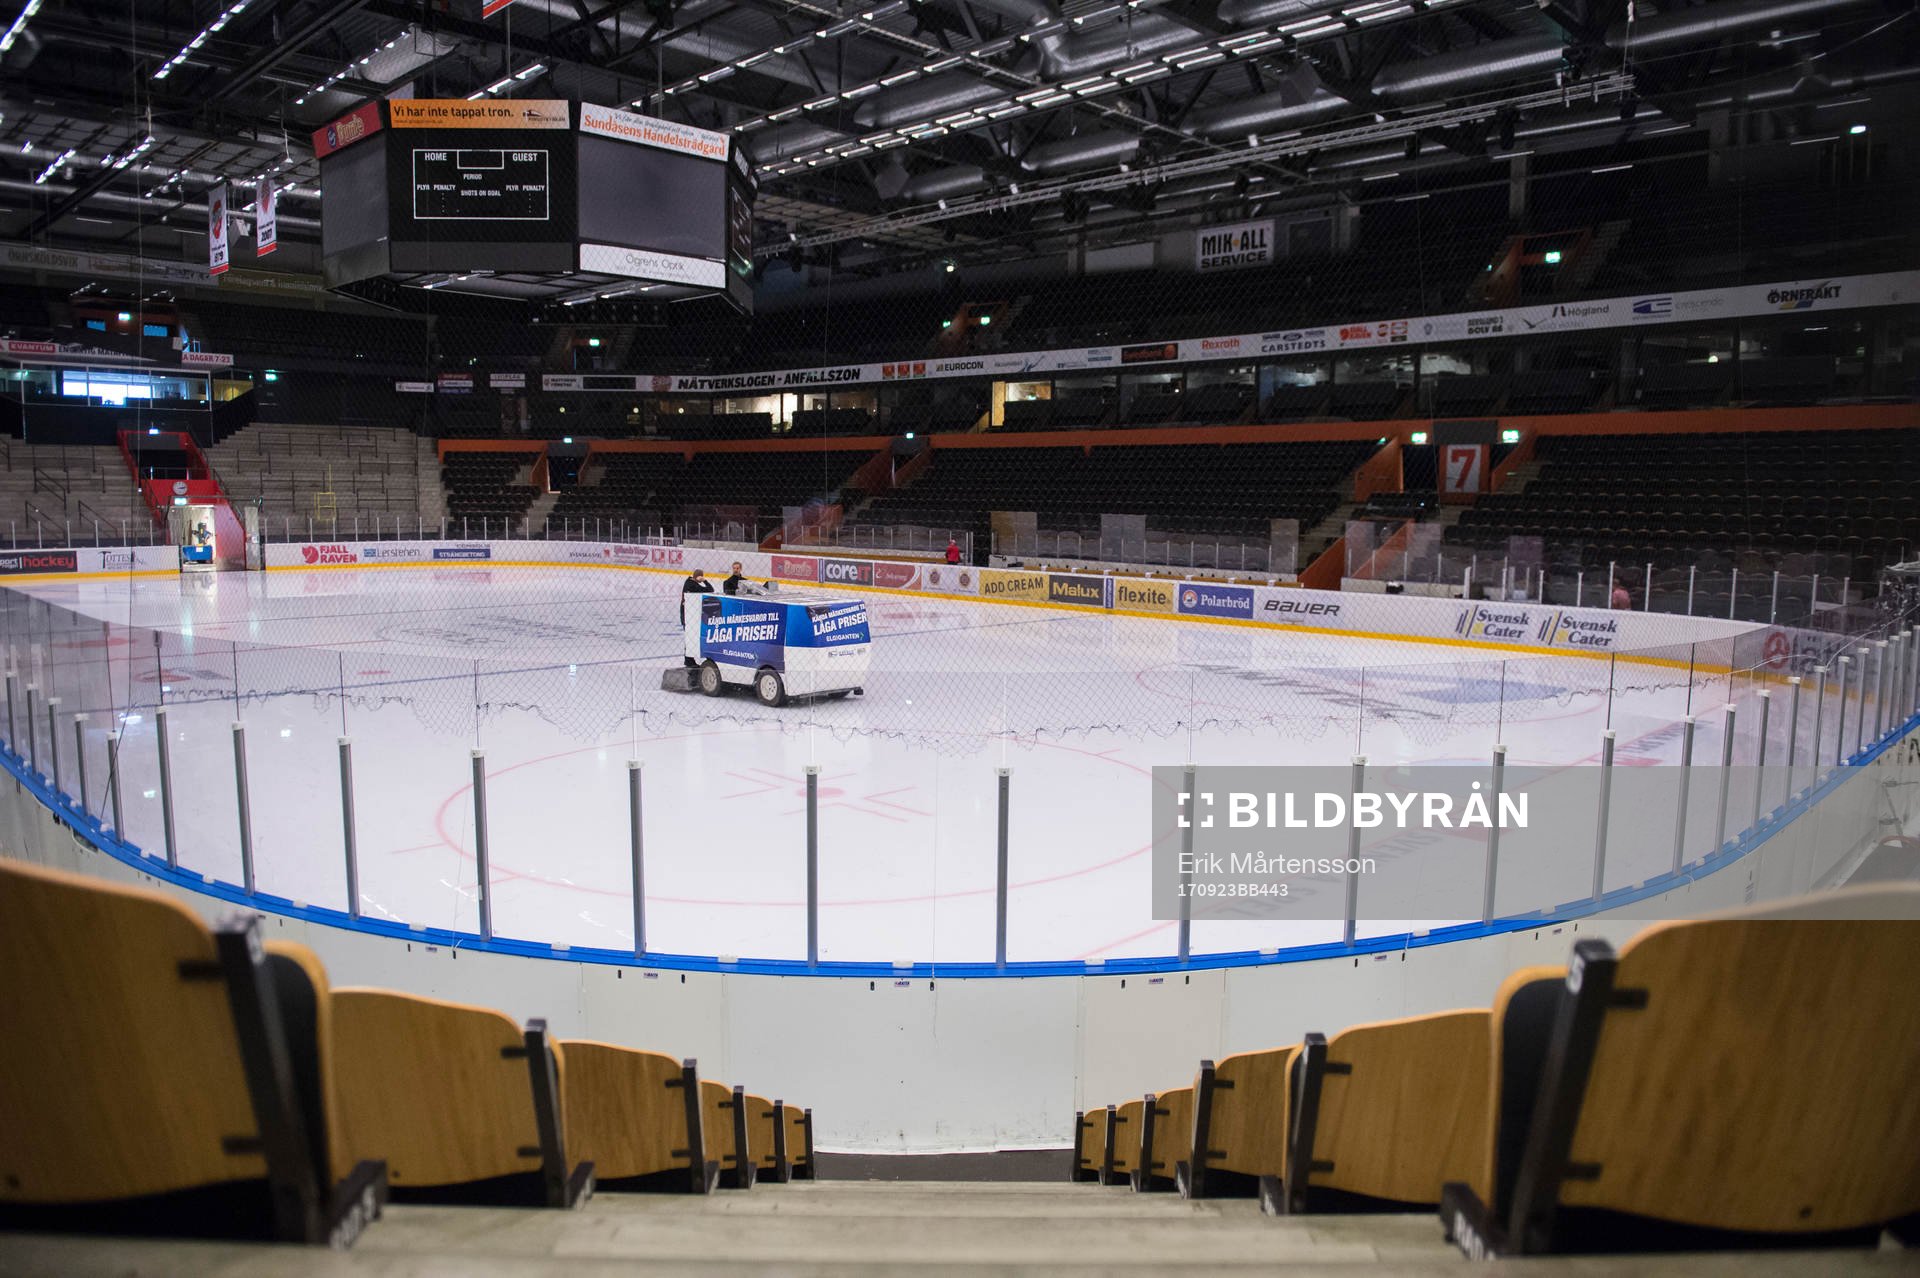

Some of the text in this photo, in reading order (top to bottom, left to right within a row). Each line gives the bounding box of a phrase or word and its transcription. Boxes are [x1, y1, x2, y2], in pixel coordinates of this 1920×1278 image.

[394, 106, 405, 117] Vi
[407, 106, 424, 117] har
[428, 106, 449, 117] inte
[451, 107, 486, 122] tappat
[488, 107, 515, 117] tron.
[424, 152, 538, 162] HOME GUEST
[463, 173, 482, 181] PERIOD
[522, 184, 545, 192] PENALTY
[1202, 228, 1267, 256] MIK ALL
[1201, 250, 1267, 269] SERVICE
[1766, 285, 1842, 304] ÖRNFRAKT
[1567, 304, 1610, 317] Högland
[10, 343, 55, 352] KVANTUM
[1201, 338, 1240, 350] Rexroth
[1260, 339, 1326, 353] CARSTEDTS
[944, 360, 984, 372] EUROCON
[1452, 448, 1476, 491] 7
[23, 555, 75, 569] hockey
[984, 579, 1004, 595] ADD
[1007, 576, 1044, 594] CREAM
[1052, 582, 1100, 599] Malux
[1118, 586, 1167, 605] flexite
[1200, 593, 1250, 610] Polarbröd
[707, 611, 780, 626] KÄNDA MÄRKESVAROR TILL
[813, 611, 867, 637] LÅGA PRISER
[1476, 609, 1530, 626] Svensk
[1560, 616, 1618, 633] Svensk
[706, 624, 779, 644] LÅGA PRISER!
[826, 633, 860, 643] ELGIGANTEN
[1483, 623, 1526, 639] Cater
[1567, 631, 1613, 648] Cater
[722, 649, 756, 661] ELGIGANTEN
